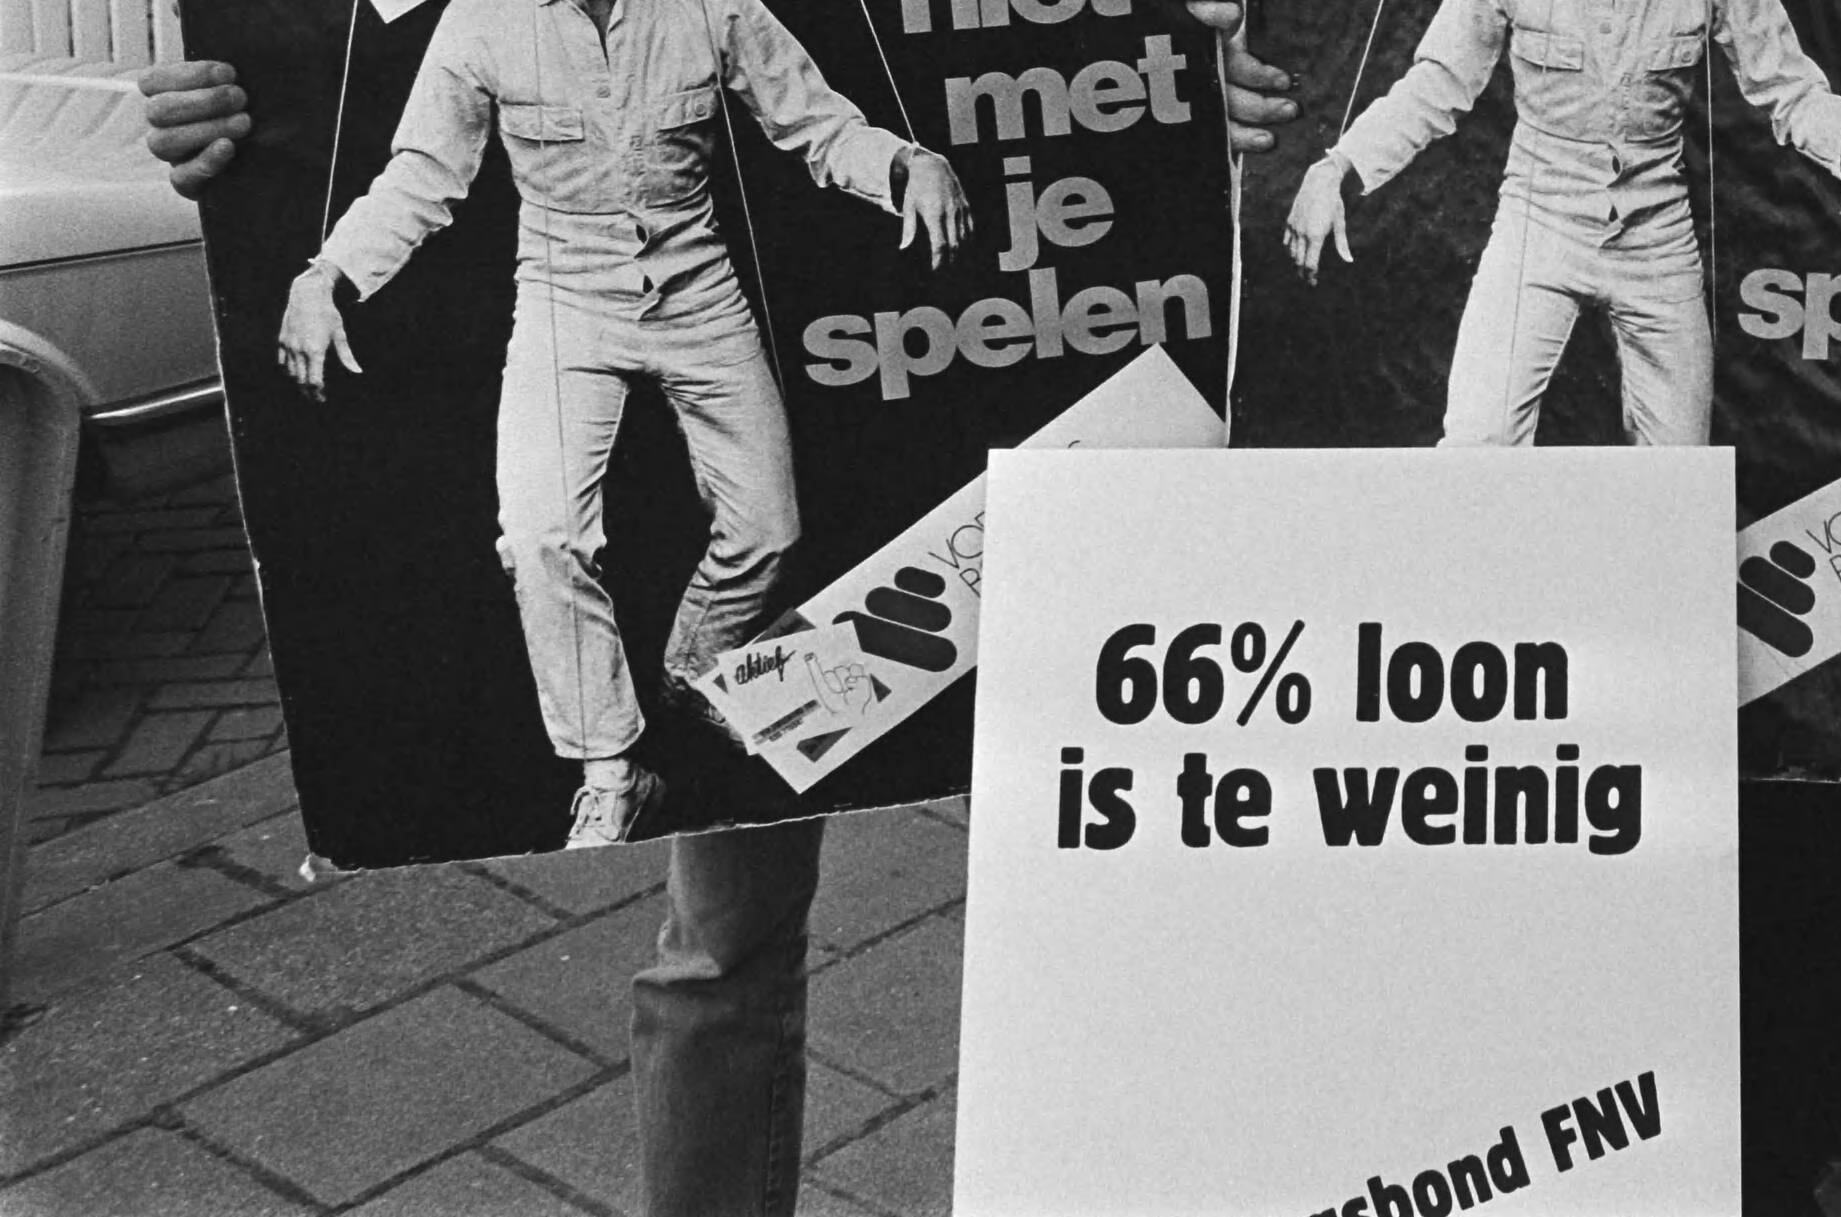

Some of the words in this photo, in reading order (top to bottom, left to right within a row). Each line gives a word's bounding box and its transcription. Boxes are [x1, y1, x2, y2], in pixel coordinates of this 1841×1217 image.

[945, 35, 1191, 145] met
[998, 156, 1114, 271] je
[803, 267, 1212, 400] spelen
[1096, 619, 1312, 727] 66%
[1357, 622, 1568, 722] loon
[1058, 747, 1136, 850] is
[1177, 752, 1272, 848] te
[1313, 744, 1642, 855] weinig
[1541, 1070, 1662, 1173] FNV
